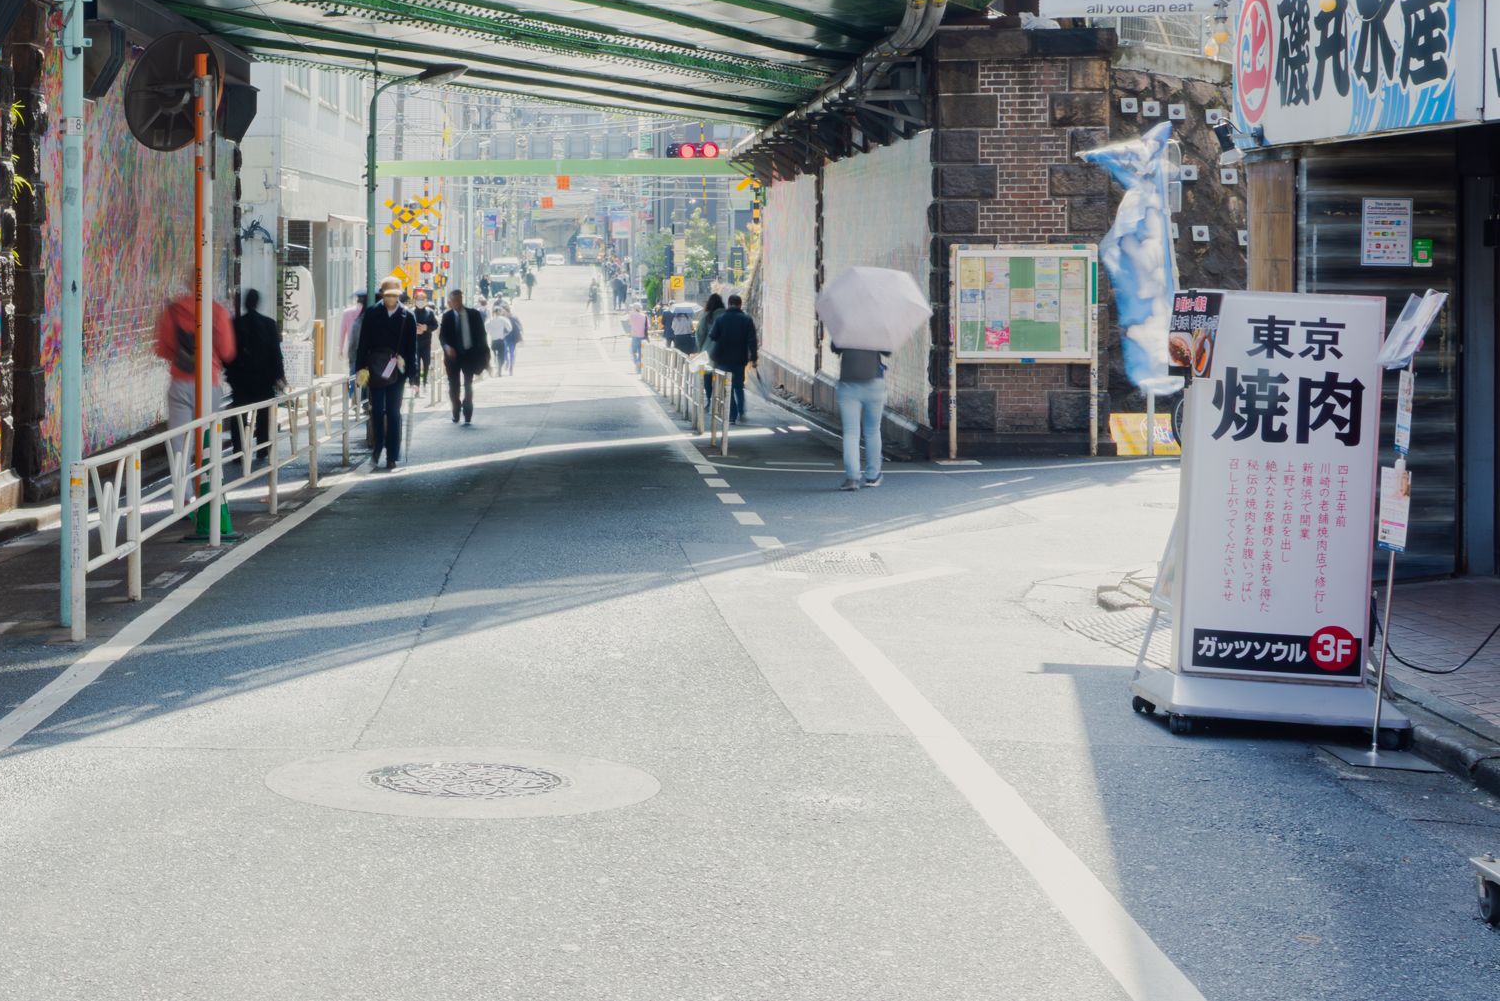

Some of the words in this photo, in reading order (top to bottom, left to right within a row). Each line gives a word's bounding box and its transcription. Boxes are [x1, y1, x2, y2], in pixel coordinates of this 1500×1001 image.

[1086, 4, 1103, 14] all
[1107, 5, 1134, 15] you
[1137, 4, 1165, 13] can
[1168, 3, 1193, 13] eat
[76, 119, 81, 130] 8
[1246, 315, 1346, 360] 東京
[1211, 366, 1365, 447] 焼肉
[1280, 460, 1296, 563] 上野でお店を出し
[1300, 461, 1314, 540] 新横浜で開業
[1335, 465, 1349, 528] 四十五年前
[1198, 636, 1307, 664] ガッツソウル
[1316, 633, 1352, 662] 3F
